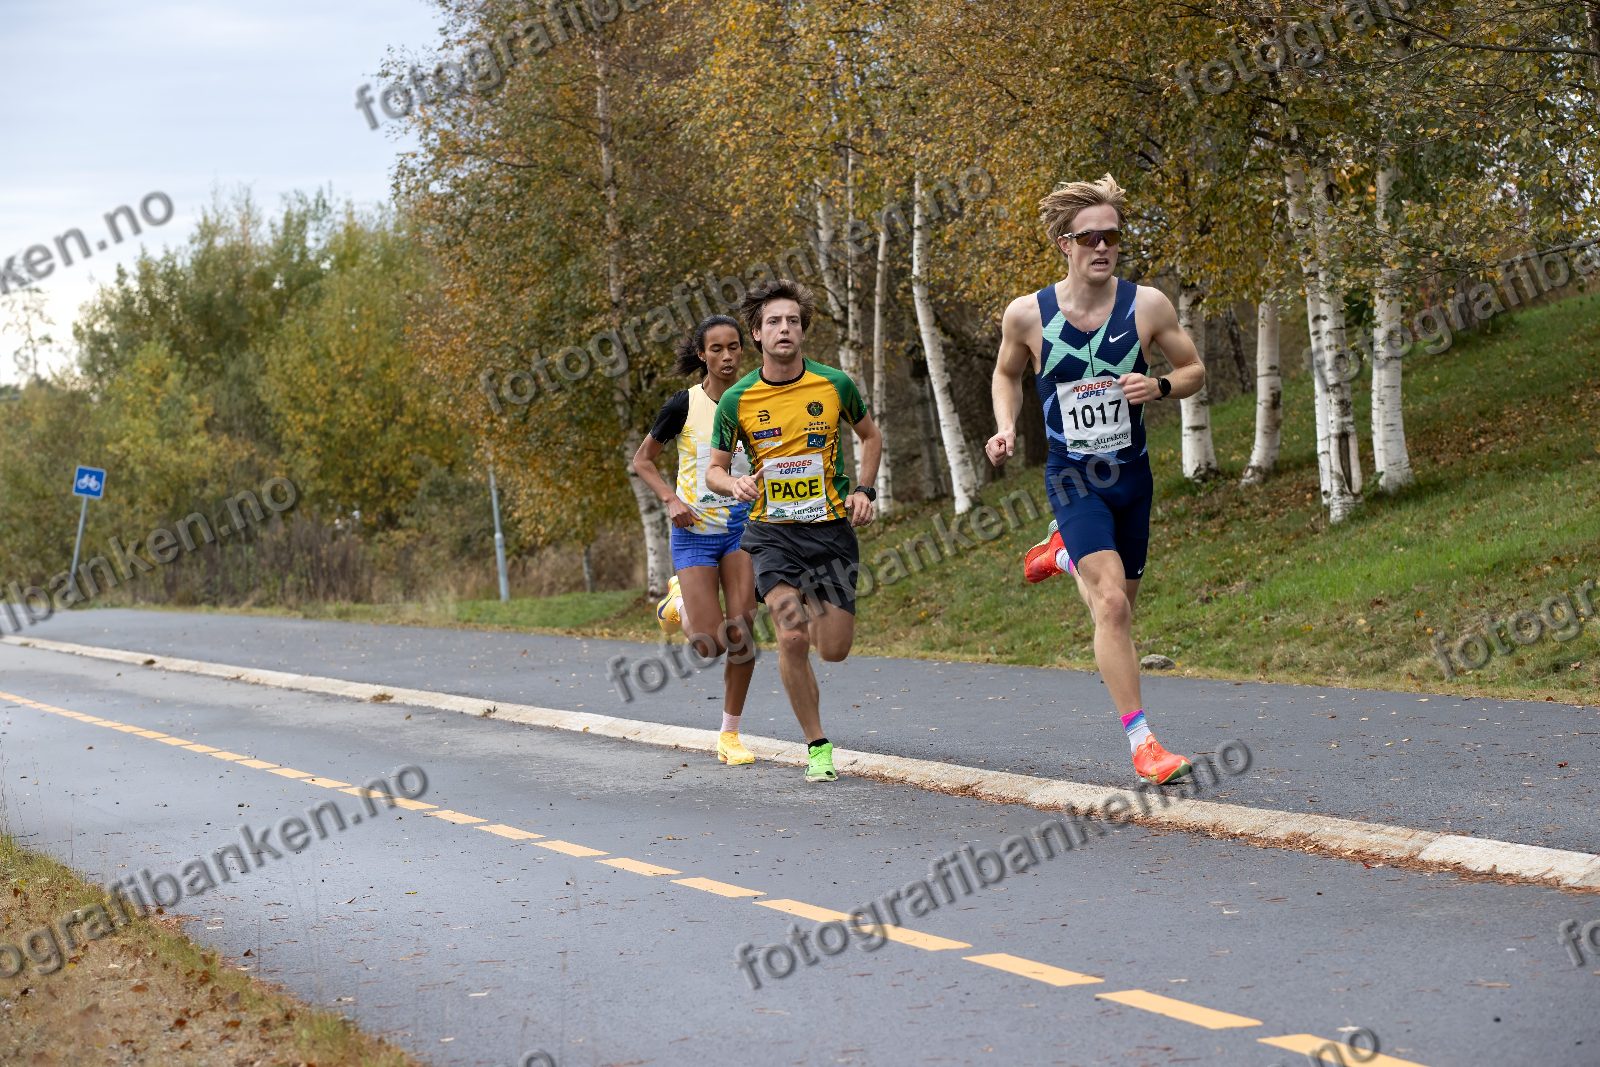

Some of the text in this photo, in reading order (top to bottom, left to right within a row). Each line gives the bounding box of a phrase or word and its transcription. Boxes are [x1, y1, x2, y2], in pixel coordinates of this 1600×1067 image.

[1072, 380, 1113, 393] NORGES
[1077, 388, 1108, 400] LØPET
[1068, 399, 1122, 430] 1017
[1093, 433, 1129, 446] Aurskog
[776, 459, 813, 469] NORGES
[780, 466, 808, 475] LØPET
[771, 478, 820, 499] PACE
